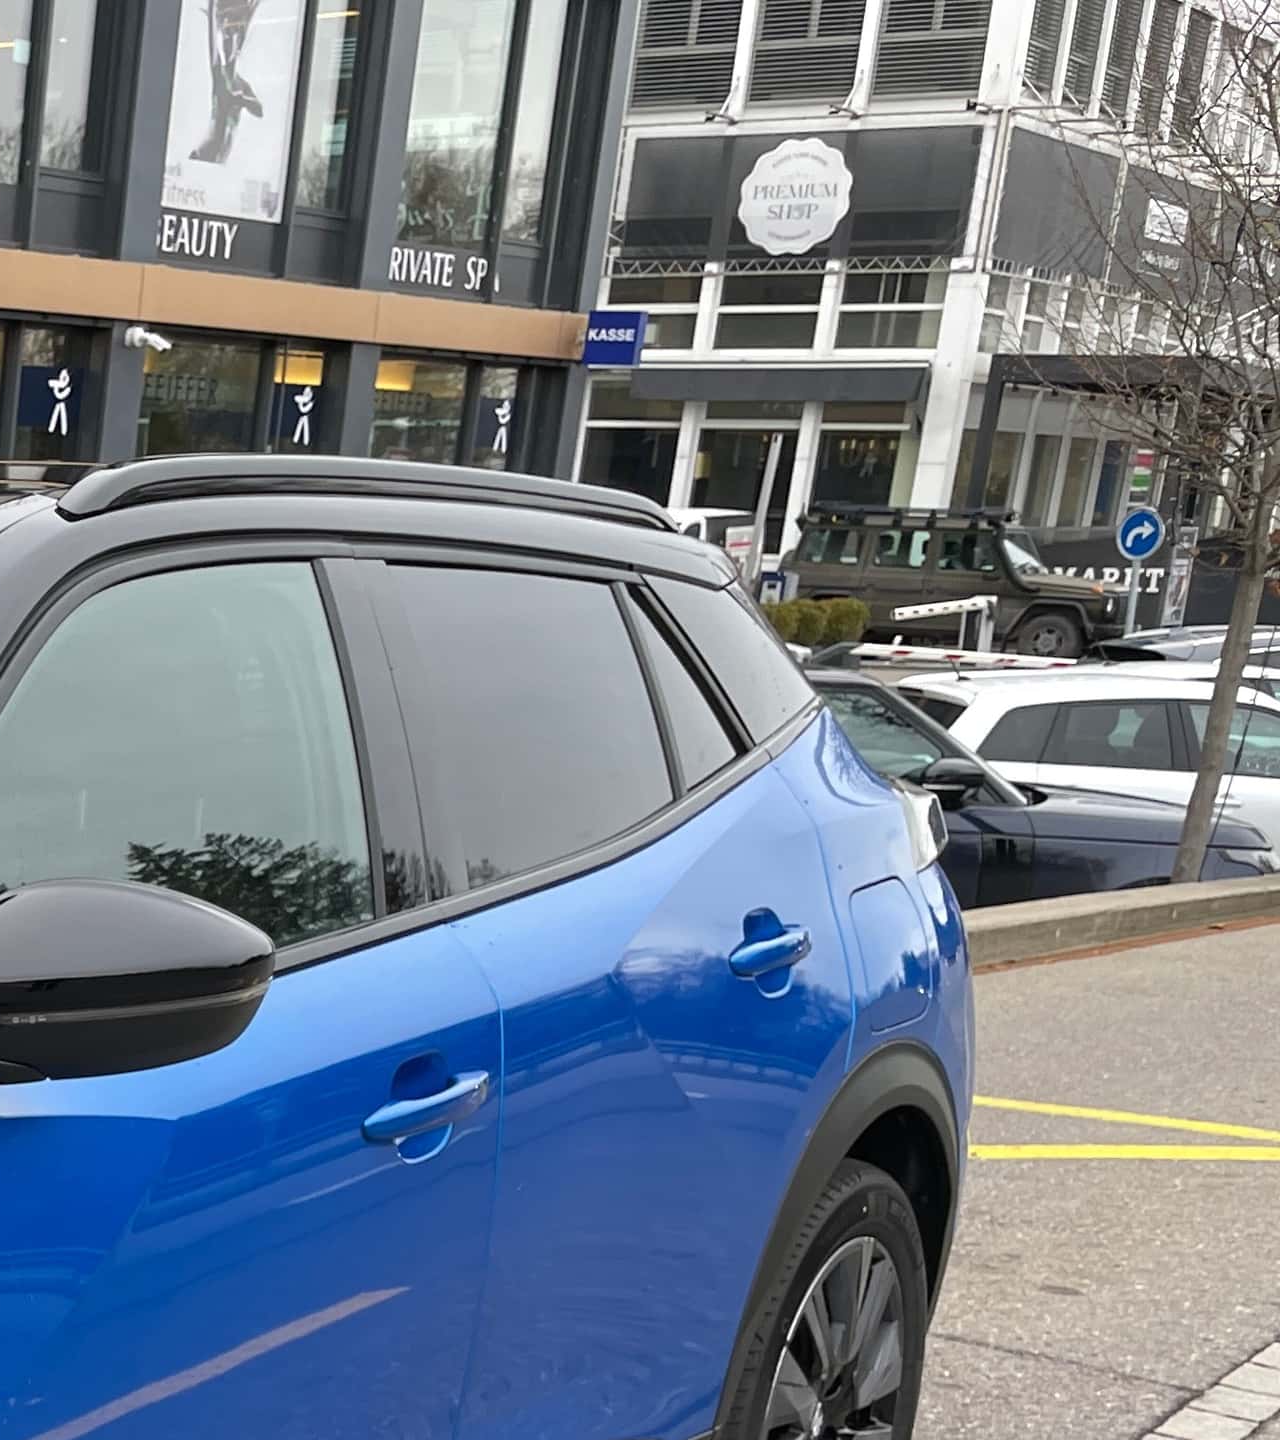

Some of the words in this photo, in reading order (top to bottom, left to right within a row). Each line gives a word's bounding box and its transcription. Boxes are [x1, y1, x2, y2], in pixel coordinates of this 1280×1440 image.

[753, 183, 838, 200] PREMIUM
[156, 214, 238, 259] EAUTY
[464, 256, 500, 292] SP
[587, 328, 635, 341] KASSE
